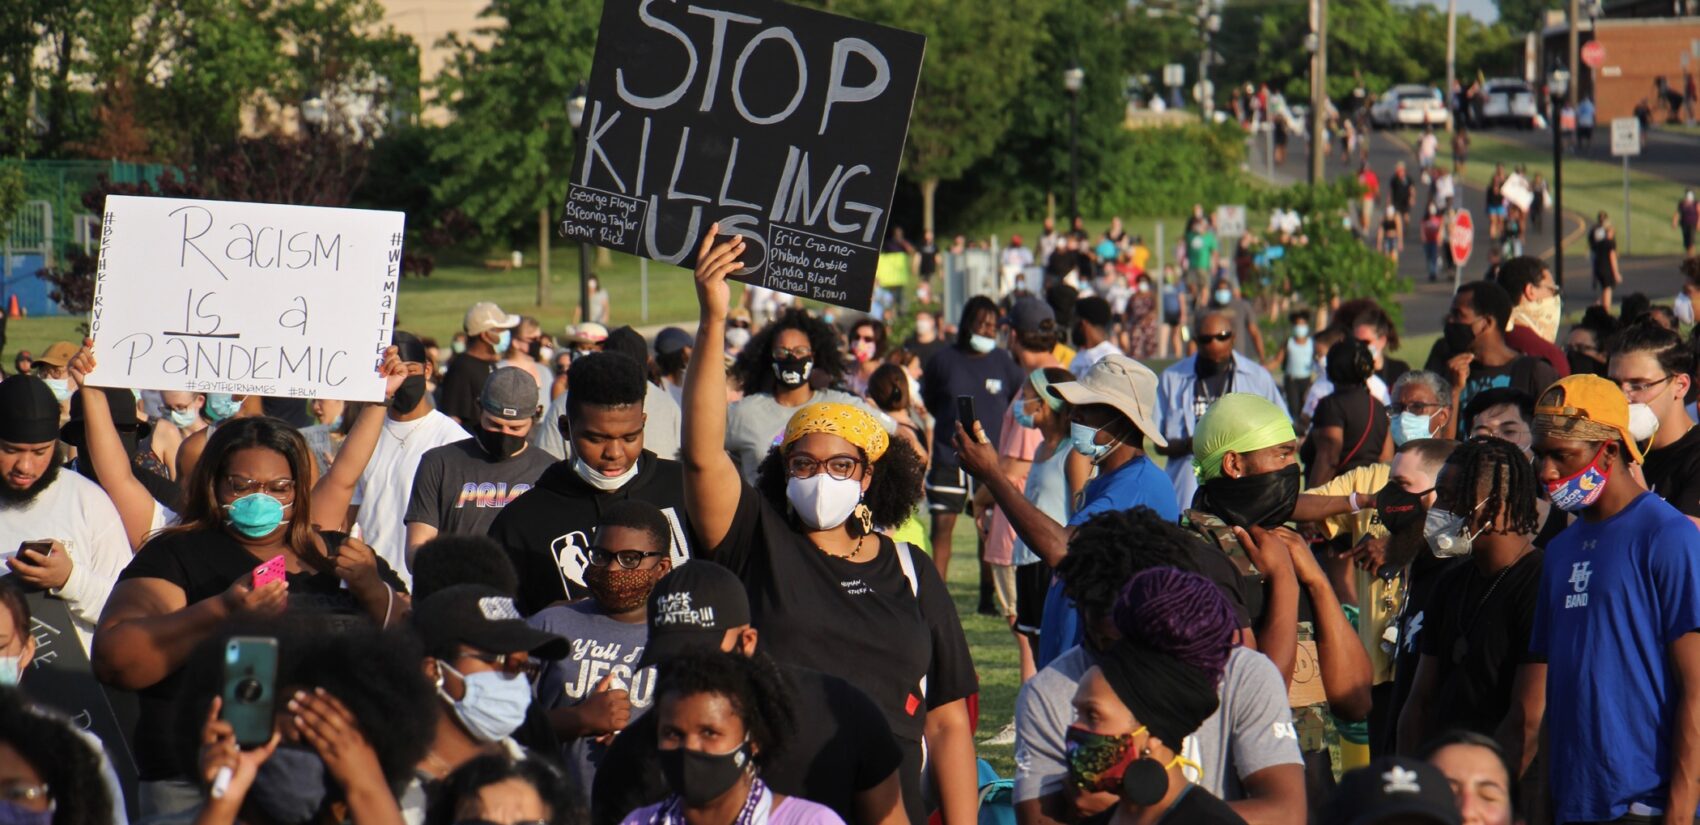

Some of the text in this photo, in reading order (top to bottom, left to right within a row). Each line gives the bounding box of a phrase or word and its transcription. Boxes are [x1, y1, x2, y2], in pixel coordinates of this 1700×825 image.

[616, 0, 891, 136] STOP
[581, 100, 884, 243] KILLING
[569, 187, 637, 219] George Floyd
[566, 201, 638, 237] Breonna Taylor
[562, 220, 625, 245] Tamir Rice
[644, 194, 768, 277] US
[774, 230, 856, 257] Eric Garner
[769, 261, 838, 286] Sandra Bland
[813, 257, 848, 273] Castile
[813, 286, 847, 301] Brown
[185, 288, 308, 335] IS a
[288, 387, 317, 398] #BLM
[658, 600, 691, 613] LIVES
[1565, 592, 1589, 609] BAND
[572, 638, 622, 661] Y'all
